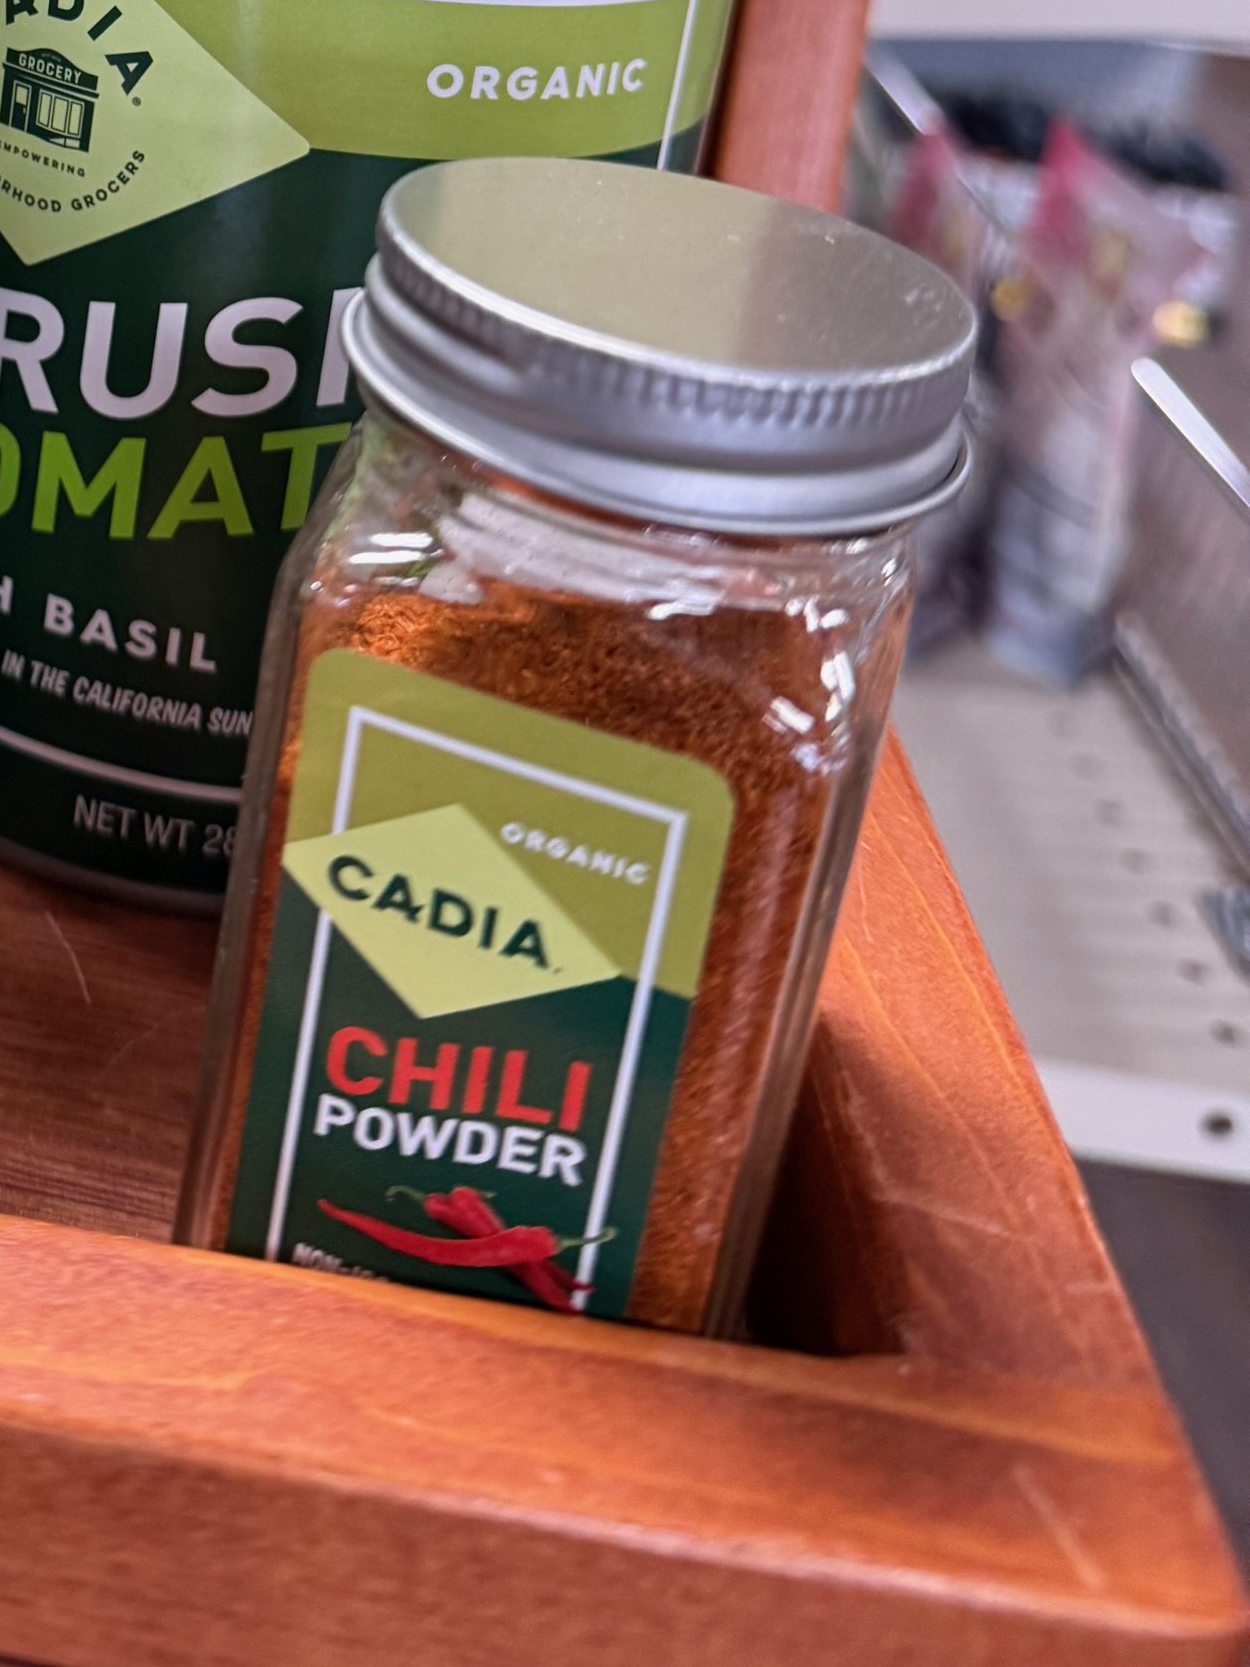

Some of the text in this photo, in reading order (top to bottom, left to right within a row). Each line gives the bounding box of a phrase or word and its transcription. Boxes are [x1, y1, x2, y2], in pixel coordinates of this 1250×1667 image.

[18, 53, 82, 84] GROCERY
[425, 58, 647, 101] ORGANIC
[70, 150, 145, 212] GROCERS
[43, 593, 218, 674] BASIL
[1, 648, 26, 681] IN
[29, 659, 70, 698] THE
[72, 675, 203, 731] CALIFORNIA
[207, 706, 252, 737] SUN
[73, 794, 137, 839] NET
[144, 812, 196, 850] WT
[500, 821, 651, 886] ORGANIC
[328, 854, 555, 973] CADIA
[326, 1026, 594, 1131] CHILI
[314, 1094, 586, 1187] POWDER
